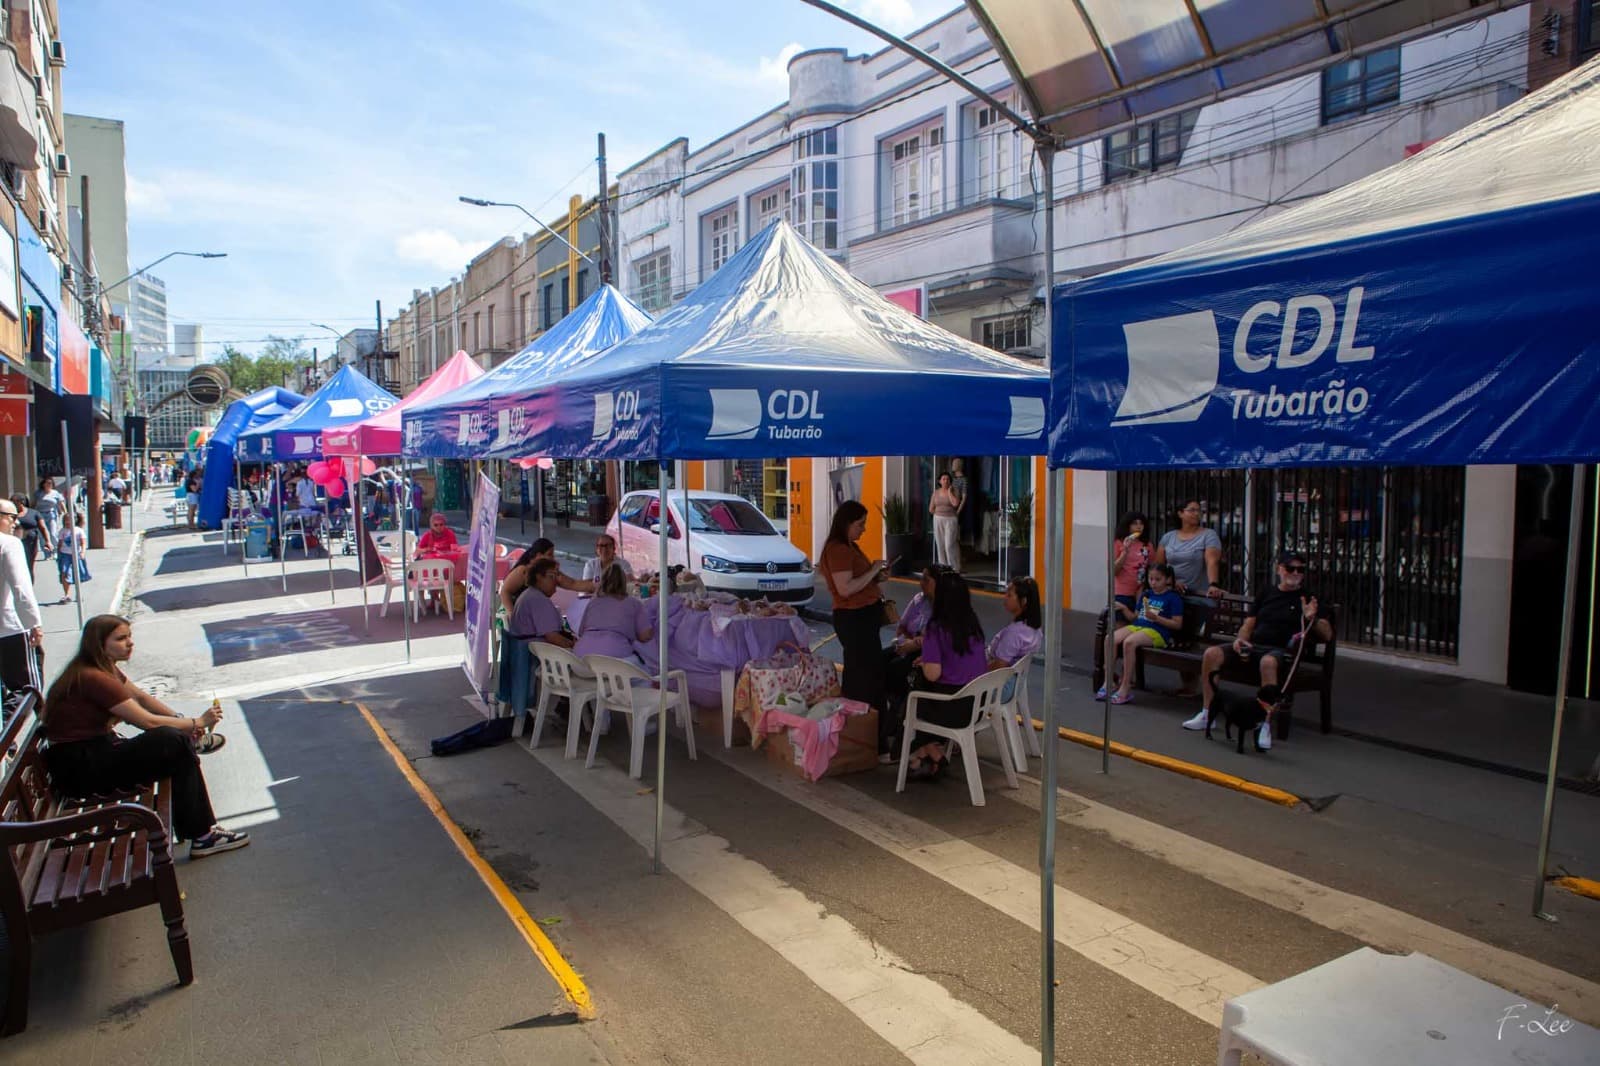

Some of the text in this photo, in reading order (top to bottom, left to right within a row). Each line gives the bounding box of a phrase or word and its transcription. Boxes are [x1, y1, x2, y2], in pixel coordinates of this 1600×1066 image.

[1233, 286, 1375, 373] CDL
[616, 389, 641, 421] CDL
[768, 389, 824, 420] CDL
[1230, 379, 1369, 420] Tubarão
[768, 425, 822, 439] Tubarão
